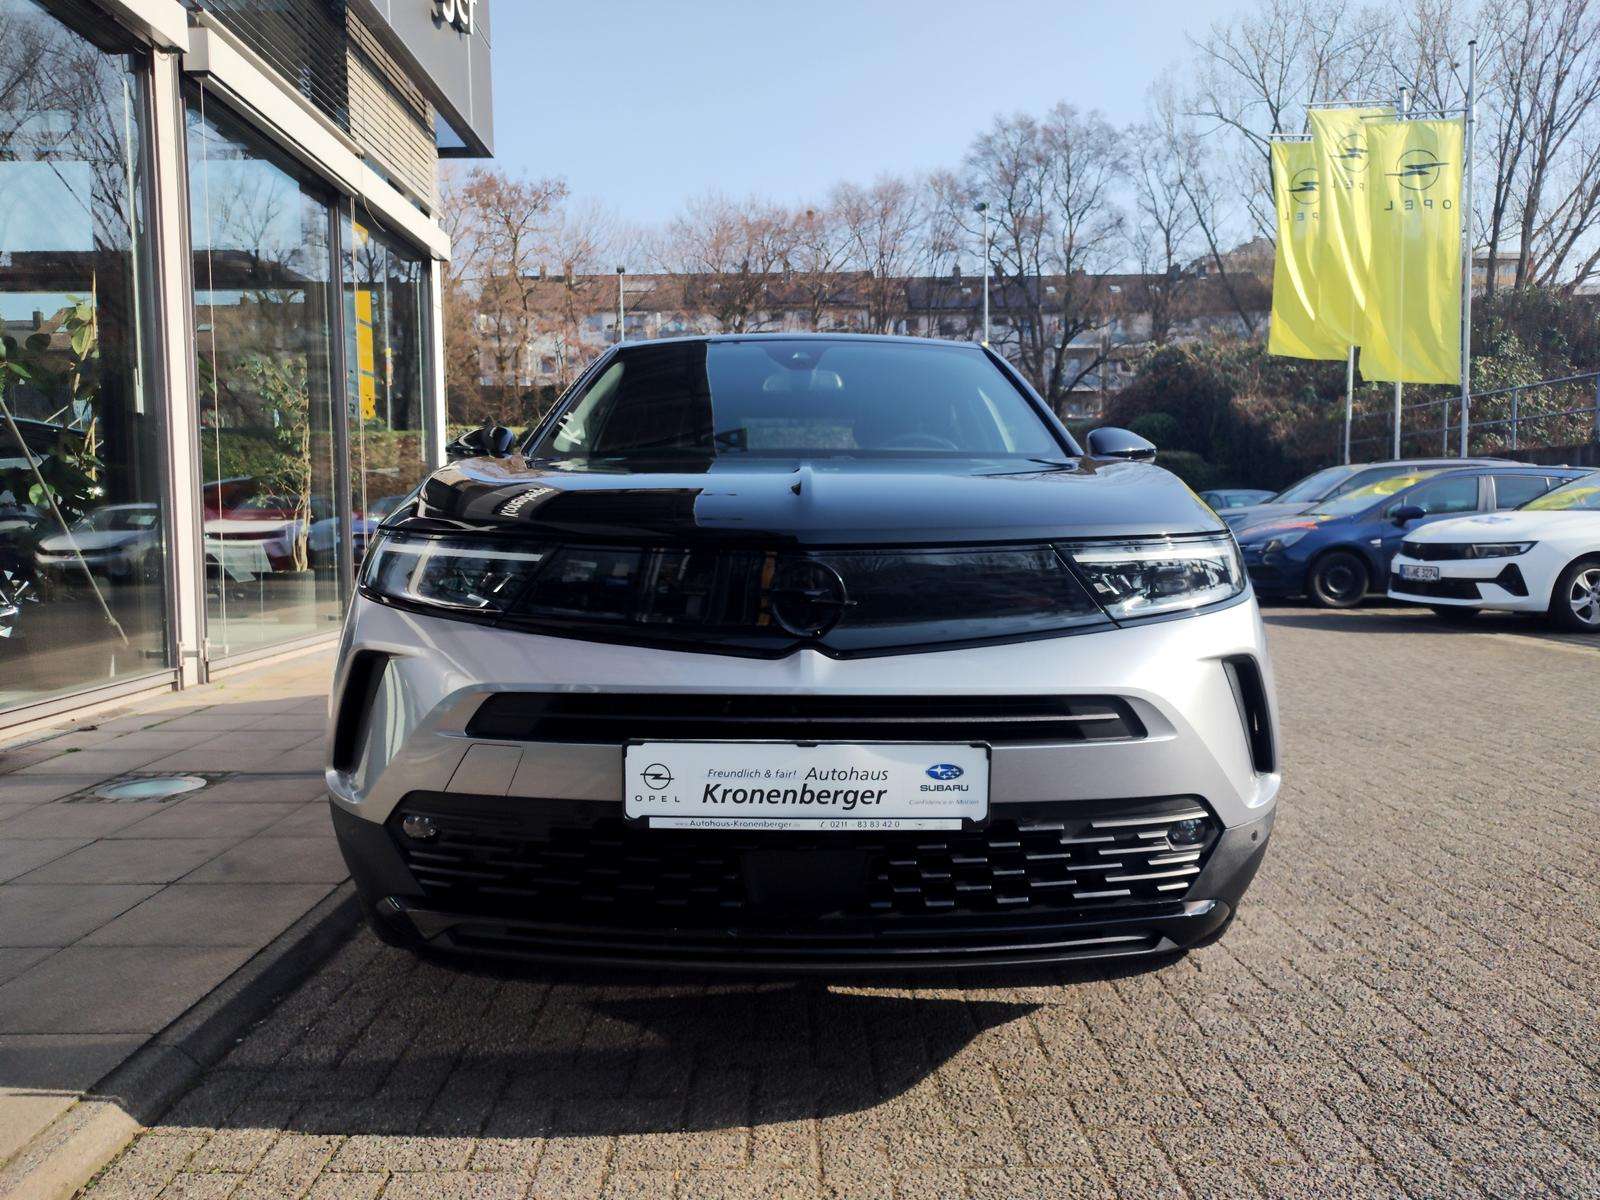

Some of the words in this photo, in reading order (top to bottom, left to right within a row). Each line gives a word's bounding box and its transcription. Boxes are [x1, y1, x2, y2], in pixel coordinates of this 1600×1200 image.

[707, 768, 761, 778] Freundlich
[763, 769, 772, 779] &
[775, 768, 797, 779] fair!
[804, 766, 889, 781] Autohaus
[919, 784, 969, 792] SUBARU
[634, 794, 681, 803] OPEL
[702, 783, 888, 811] Kronenberger
